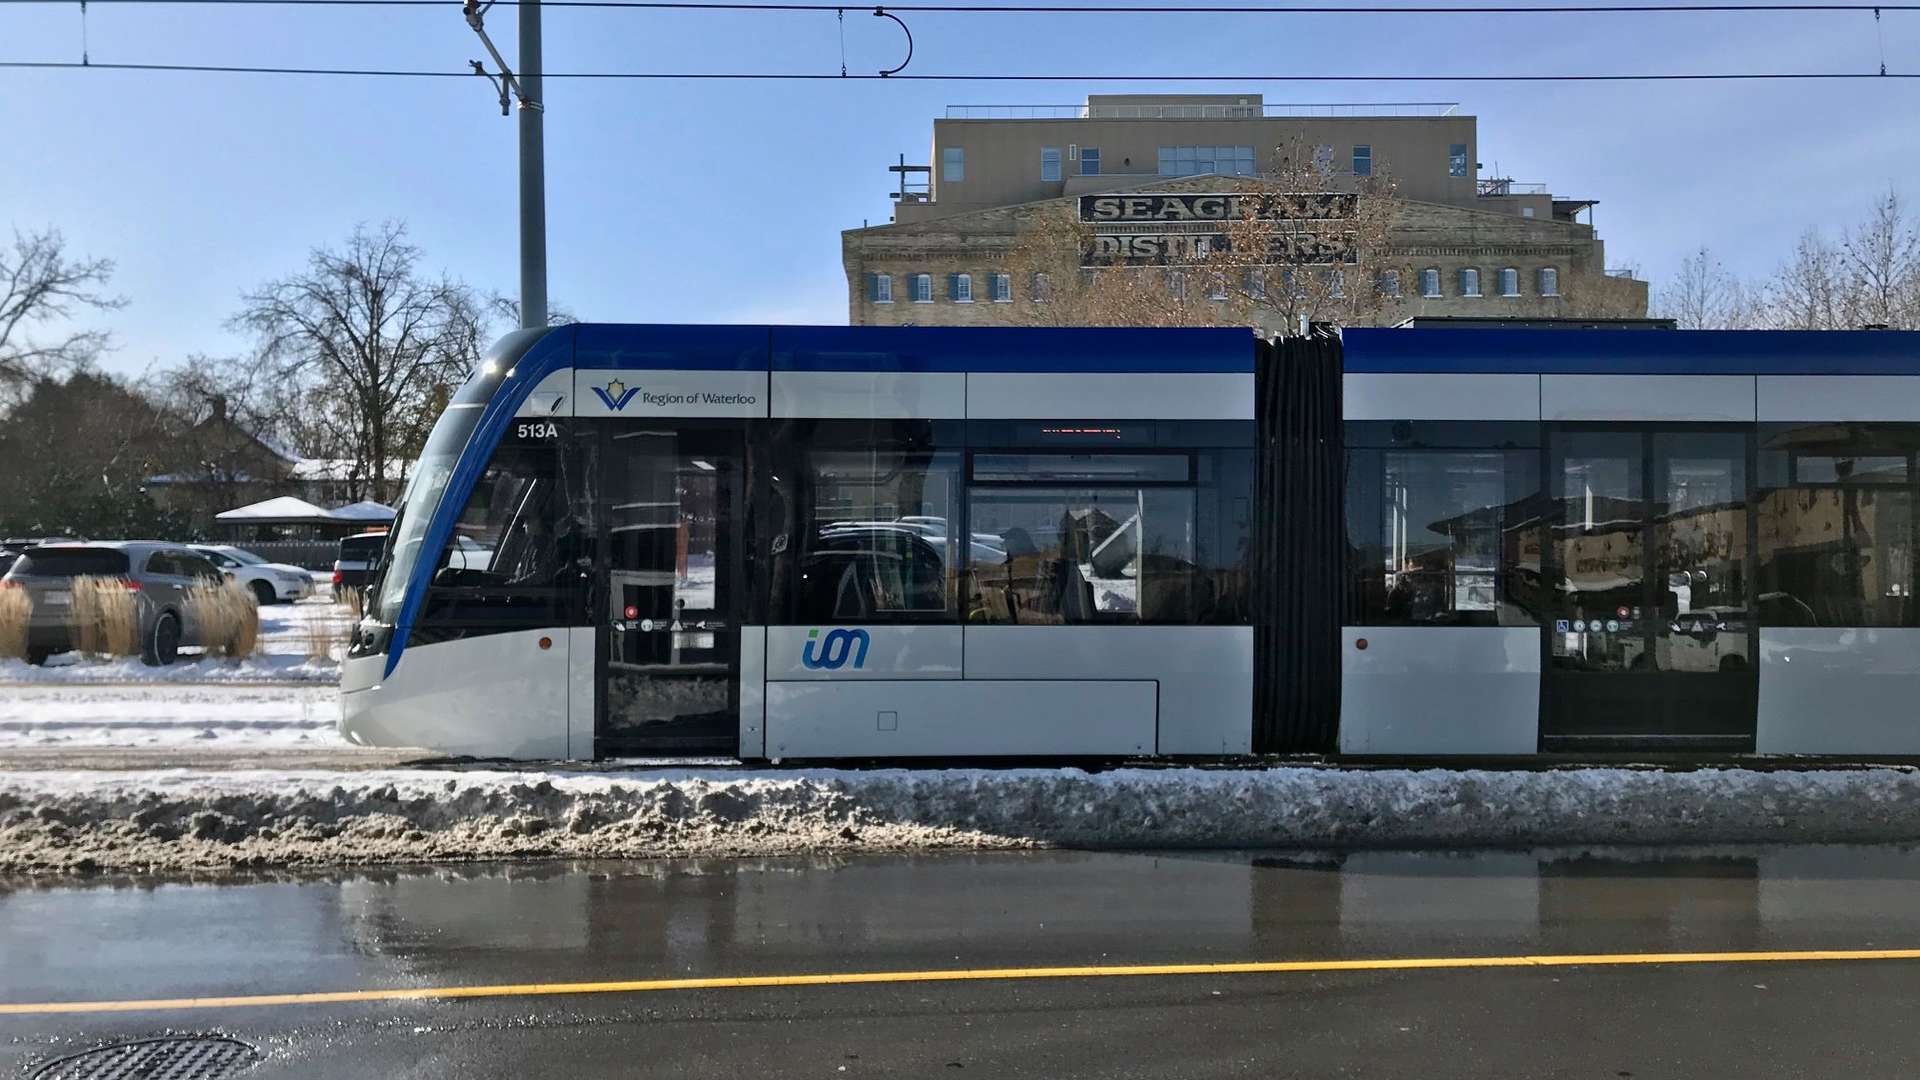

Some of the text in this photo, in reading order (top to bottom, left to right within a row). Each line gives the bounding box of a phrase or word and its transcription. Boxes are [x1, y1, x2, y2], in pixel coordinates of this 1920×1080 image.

[1093, 197, 1346, 219] SEAGRAM
[1094, 235, 1345, 257] DISTILERS
[643, 393, 756, 406] Region of Waterloo
[518, 423, 558, 438] 513A
